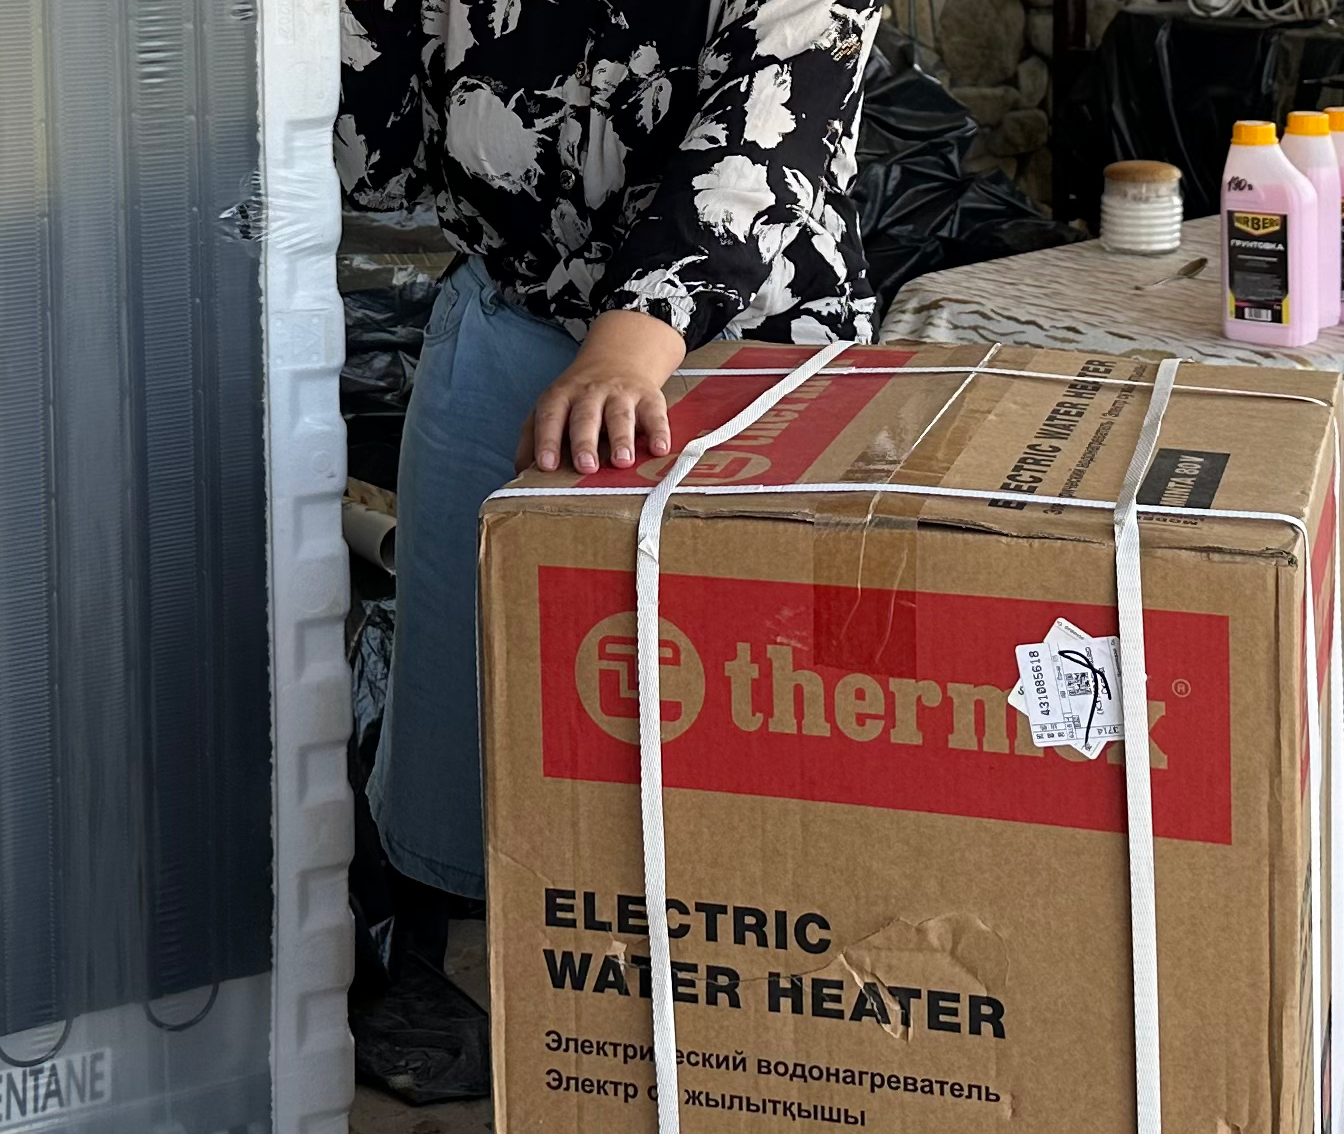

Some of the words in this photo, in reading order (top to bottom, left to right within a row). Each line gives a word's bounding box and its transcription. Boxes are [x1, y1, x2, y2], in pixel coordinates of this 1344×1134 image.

[988, 443, 1061, 510] EECTRIC
[1035, 401, 1090, 440] WATER
[724, 642, 1169, 770] thermx
[1028, 650, 1051, 716] 431085618
[544, 887, 832, 954] ELECTRIC
[767, 971, 1007, 1040] HEATER
[544, 1030, 748, 1073] Электриеский
[757, 1057, 1002, 1104] водонагреватель
[544, 1068, 640, 1103] Электр
[684, 1088, 867, 1127] жылытқышы
